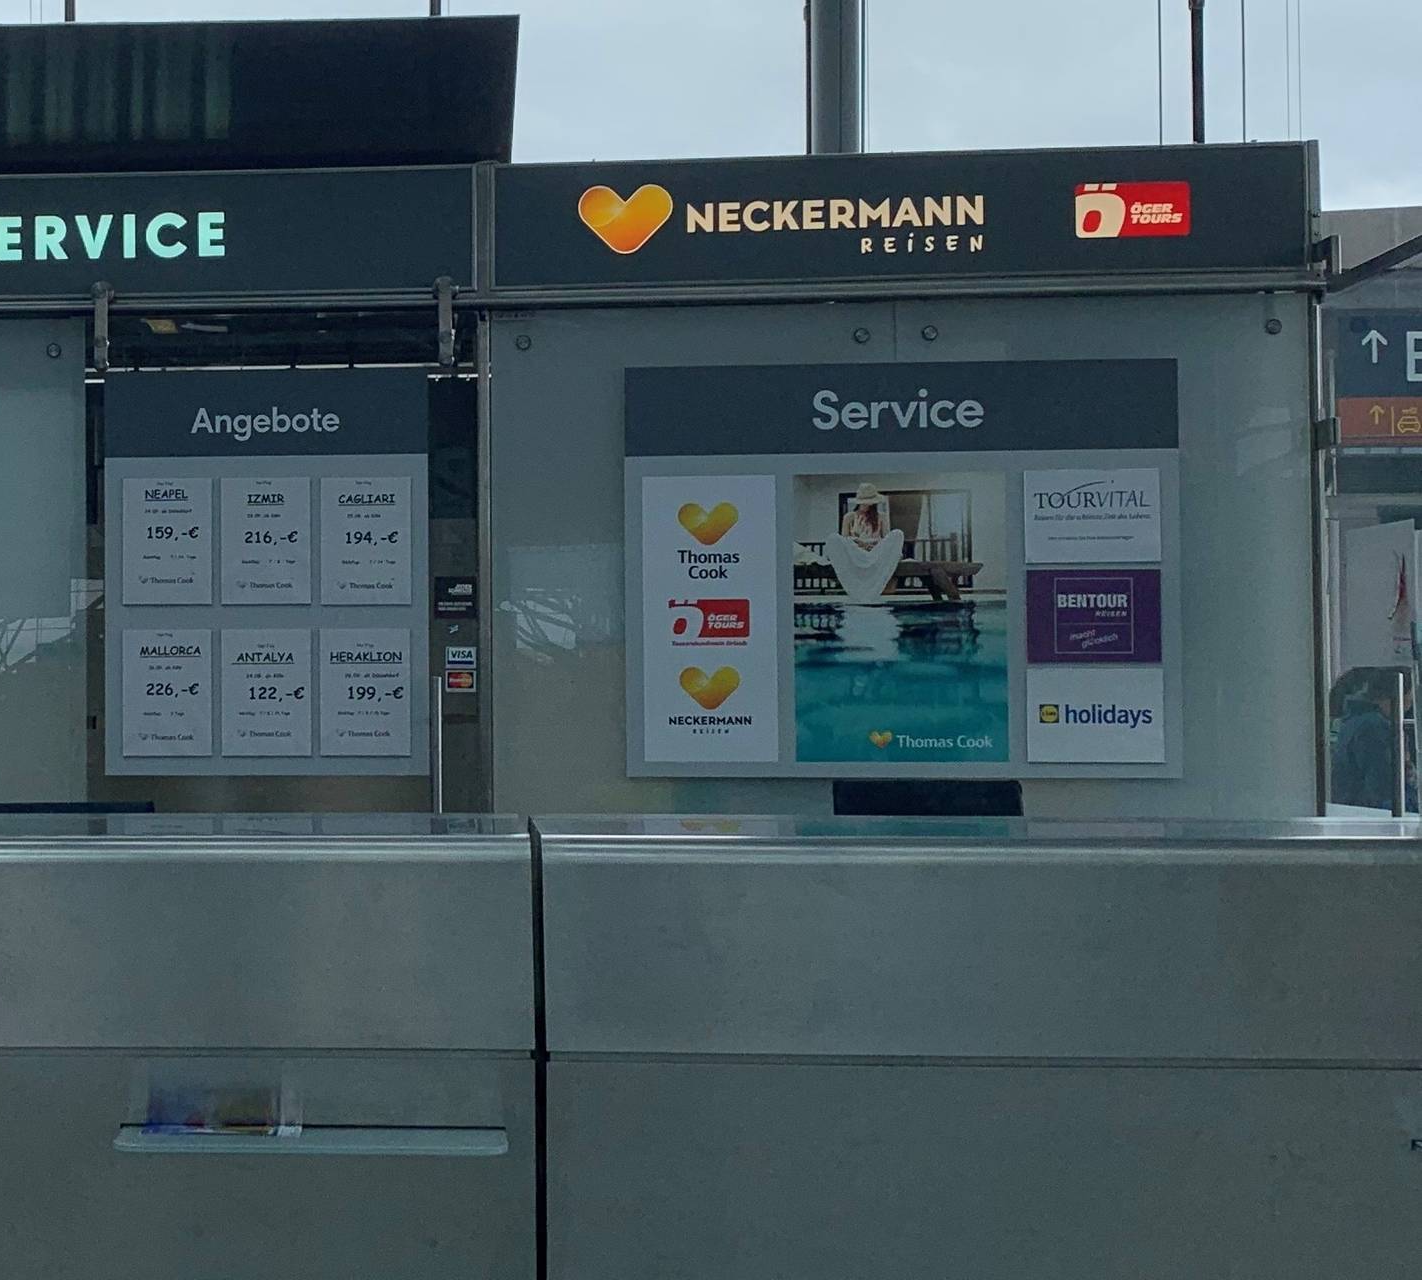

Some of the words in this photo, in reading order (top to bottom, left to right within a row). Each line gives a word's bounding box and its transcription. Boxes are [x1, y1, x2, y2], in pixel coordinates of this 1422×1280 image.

[1130, 202, 1174, 213] ÖGER
[686, 195, 985, 233] NECKERMANN
[1130, 213, 1183, 225] TOURS
[812, 388, 985, 431] Service
[190, 406, 341, 442] Angebote
[145, 489, 189, 500] NEAPEL
[247, 493, 285, 504] IZMIR
[338, 494, 396, 504] CAGLIARI
[677, 550, 740, 564] Thomas
[688, 565, 729, 579] Cook
[1058, 593, 1128, 608] BENTOUR
[708, 621, 745, 629] TOURS
[139, 646, 201, 656] MALLORCA
[330, 651, 402, 662] HERAKLION
[450, 651, 473, 660] VISA
[237, 652, 294, 662] ANTALYA
[668, 715, 753, 726] NECKERMANN
[1065, 704, 1153, 728] holidays
[896, 735, 953, 748] Thomas
[957, 735, 993, 748] Cook
